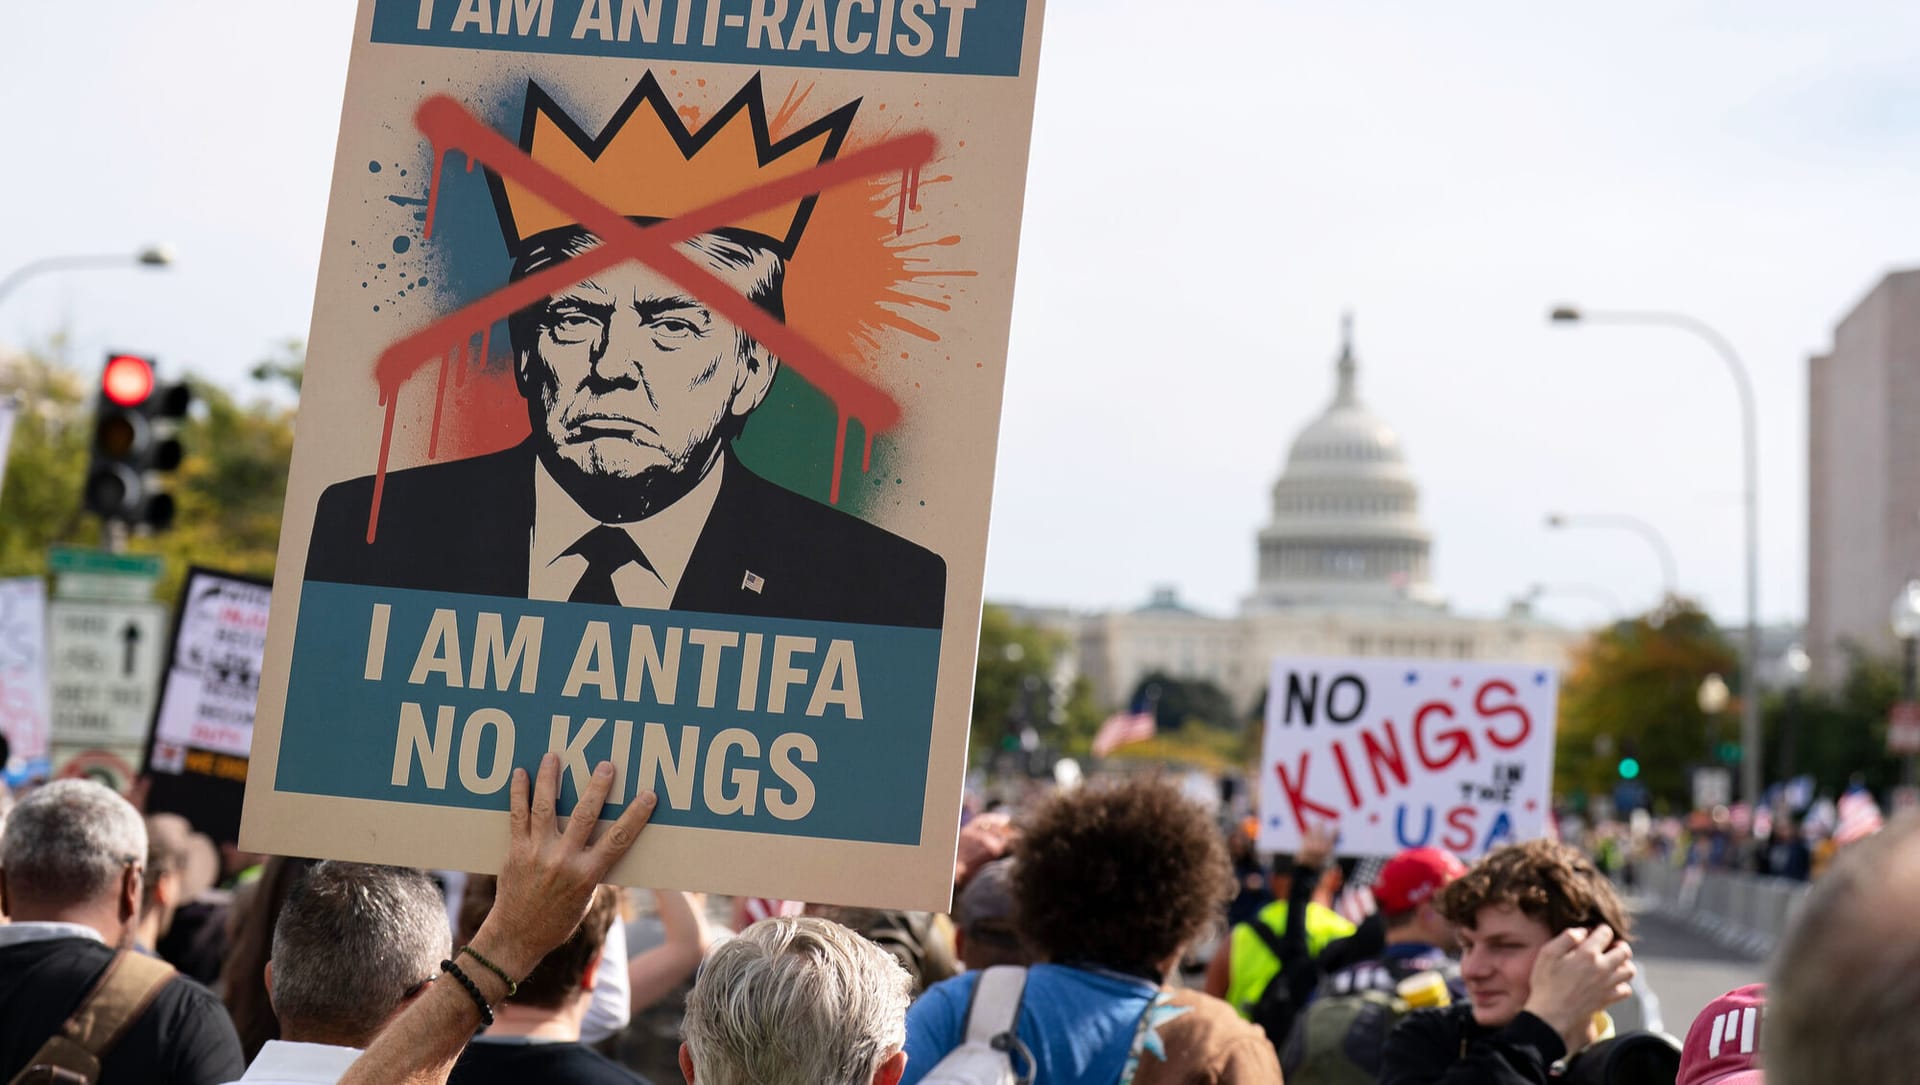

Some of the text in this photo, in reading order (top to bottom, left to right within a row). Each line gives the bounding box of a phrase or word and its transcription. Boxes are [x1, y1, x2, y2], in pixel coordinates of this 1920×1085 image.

[450, 0, 554, 37] AM
[570, 0, 977, 58] ANTI-RACIST
[364, 603, 864, 720] I AM ANTIFA
[1284, 671, 1369, 728] NO
[391, 701, 517, 797] NO
[548, 714, 819, 822] KINGS
[1275, 679, 1533, 834] KINGS
[1394, 805, 1513, 852] USA
